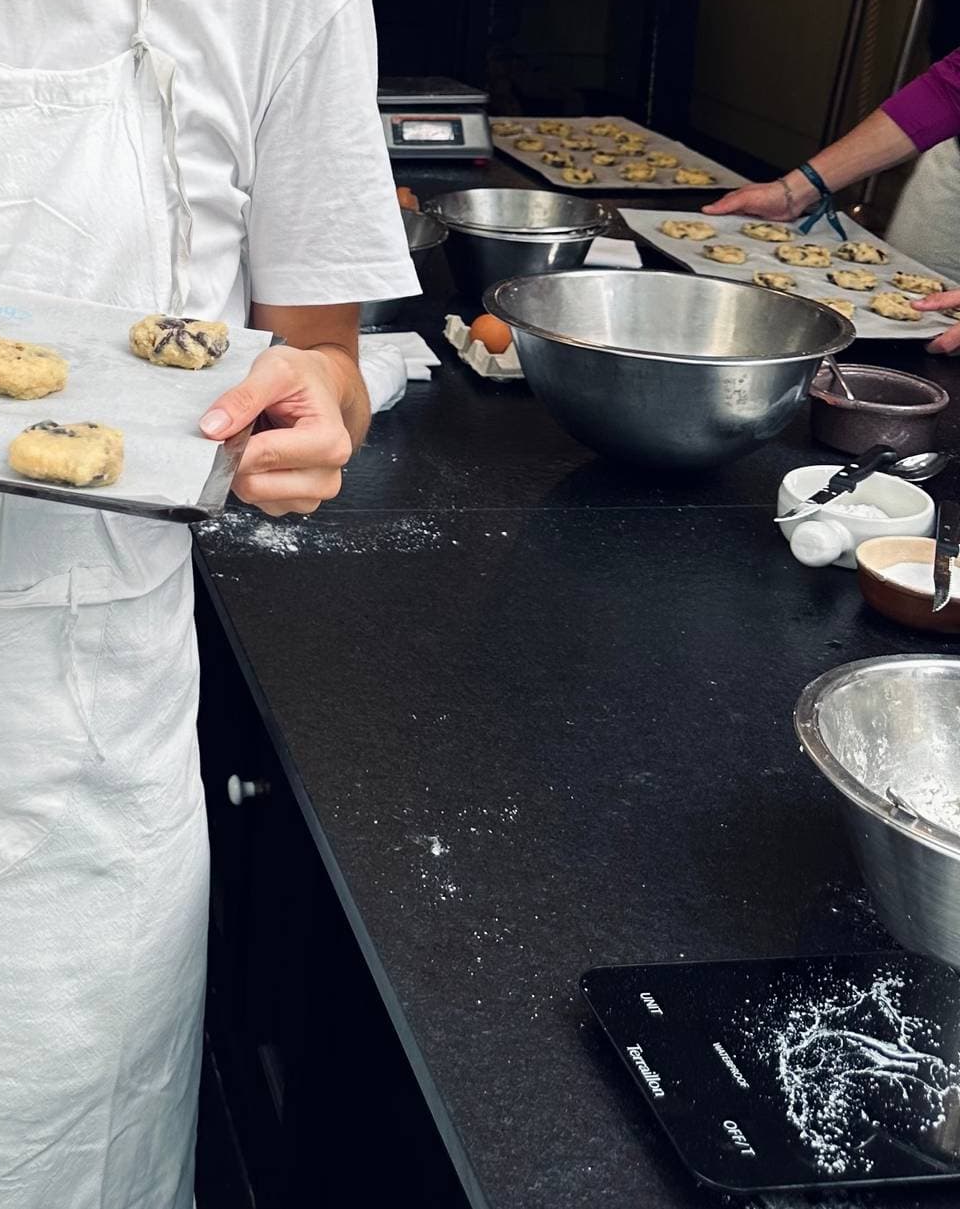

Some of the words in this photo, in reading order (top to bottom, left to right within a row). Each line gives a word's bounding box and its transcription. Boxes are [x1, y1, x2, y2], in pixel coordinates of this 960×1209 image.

[640, 992, 663, 1015] UNIT
[626, 1043, 665, 1097] Terraillon
[712, 1042, 750, 1088] WATERPROOF
